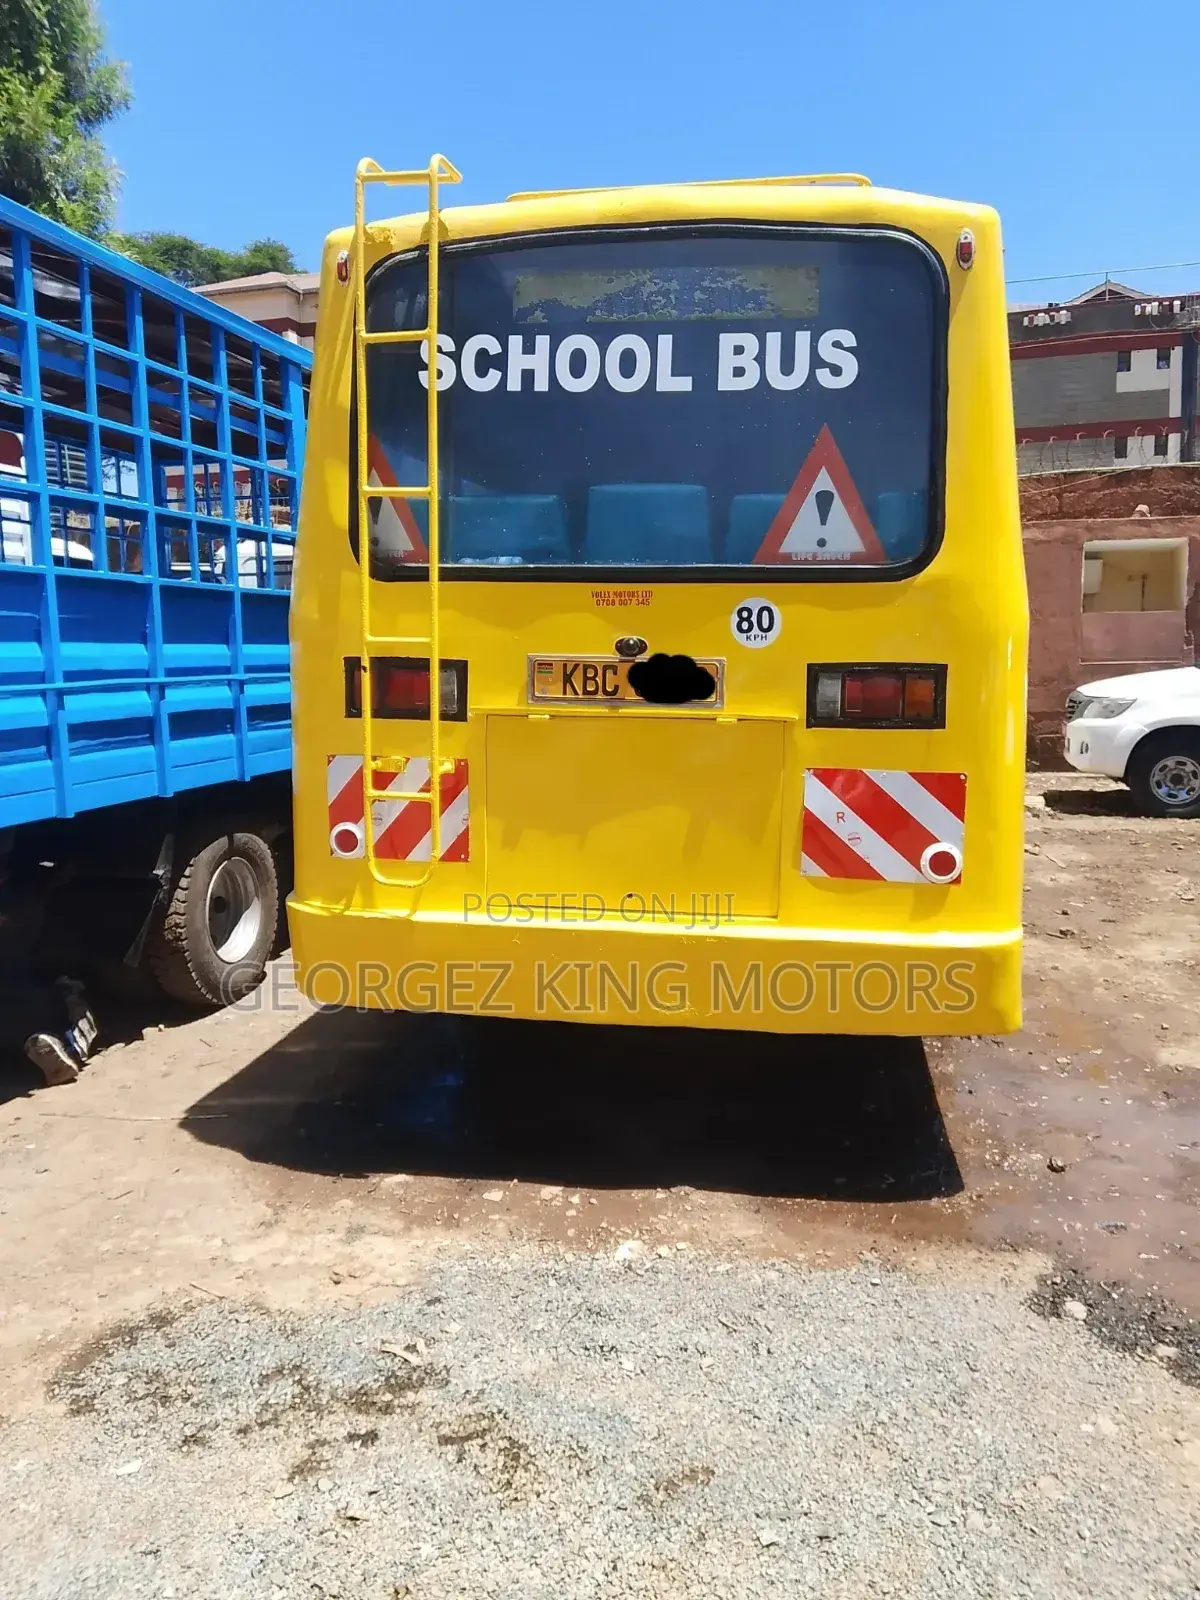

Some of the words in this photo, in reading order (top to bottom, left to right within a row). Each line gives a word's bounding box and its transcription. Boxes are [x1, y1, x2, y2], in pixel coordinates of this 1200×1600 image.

[417, 333, 693, 393] SCHOOL
[717, 329, 859, 391] BUS
[612, 590, 640, 599] MOTORS
[641, 590, 653, 598] LTD
[595, 599, 616, 607] 0708
[618, 599, 633, 607] 007
[736, 605, 775, 634] 80
[745, 634, 768, 642] KPH
[561, 662, 620, 697] KBC
[836, 811, 846, 824] R
